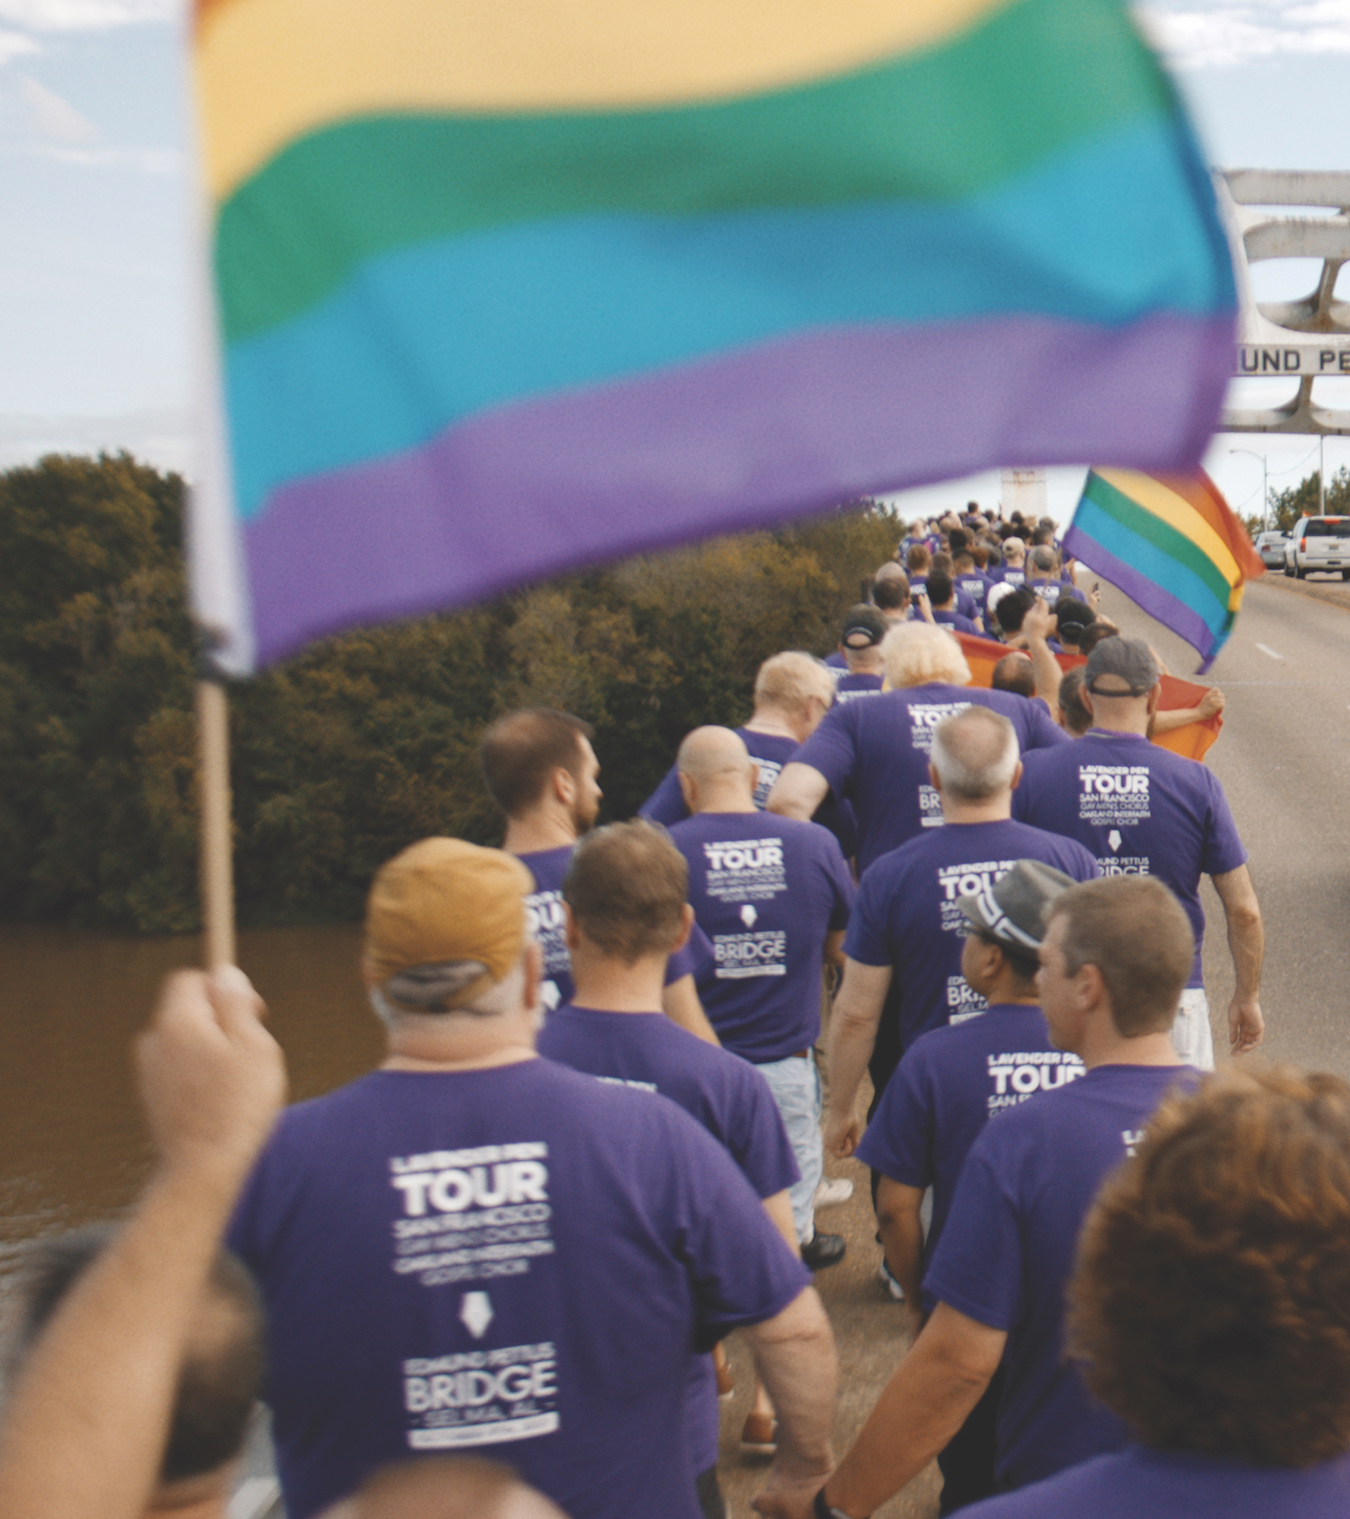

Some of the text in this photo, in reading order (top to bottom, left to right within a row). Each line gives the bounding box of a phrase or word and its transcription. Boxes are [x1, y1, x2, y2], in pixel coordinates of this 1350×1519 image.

[1240, 350, 1300, 372] UND
[1080, 765, 1149, 775] LAVENDER PEN
[1080, 774, 1149, 794] TOUR
[1080, 793, 1150, 803] SAN FRANCISCO
[1080, 810, 1113, 819] OAKLAND
[704, 846, 784, 871] TOUR
[1120, 857, 1149, 866] PETTUS
[939, 861, 998, 877] LAVENDER
[714, 940, 786, 961] BRIDGE
[988, 1052, 1062, 1066] LAVENDER
[391, 1160, 549, 1217] TOUR
[405, 1360, 560, 1413] BRIDGE
